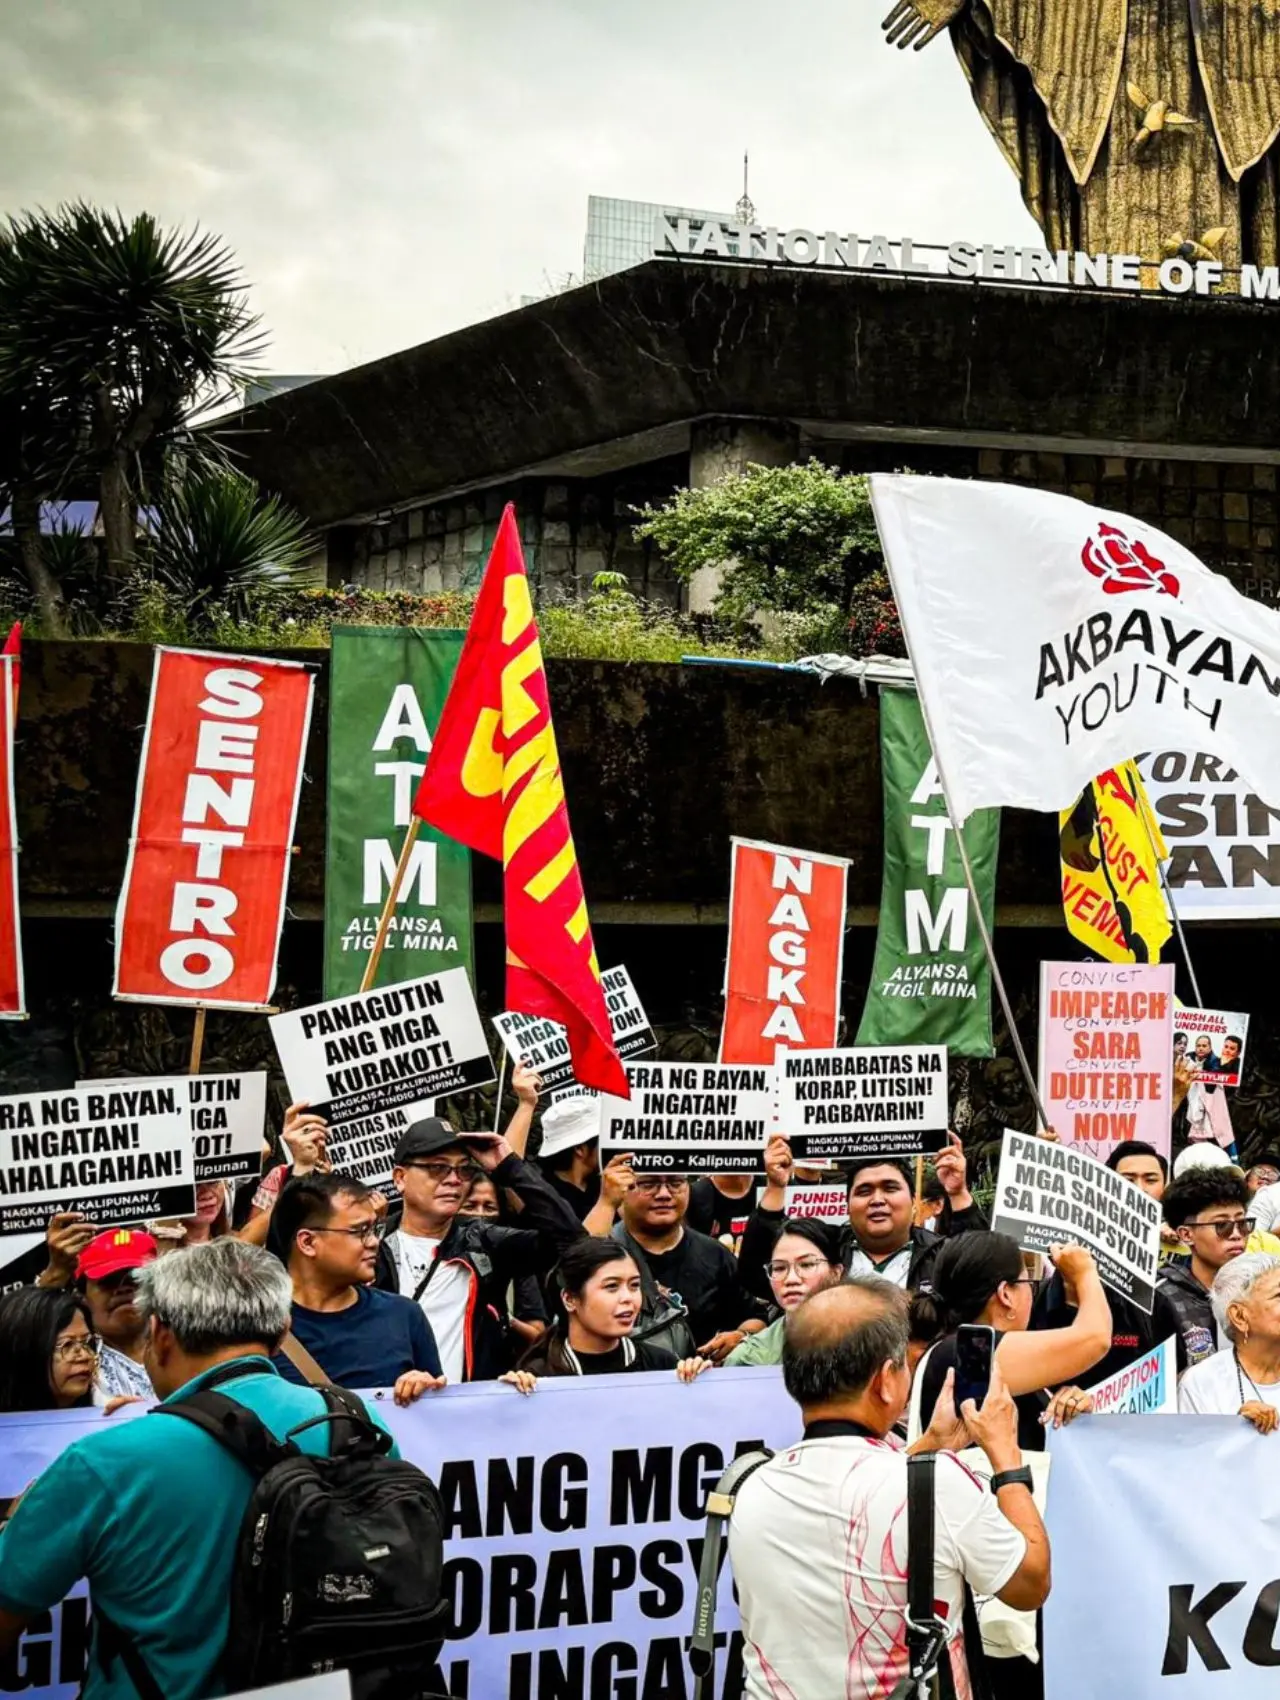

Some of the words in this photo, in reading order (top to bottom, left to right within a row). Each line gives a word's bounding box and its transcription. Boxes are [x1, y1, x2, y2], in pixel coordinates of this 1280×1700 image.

[653, 216, 929, 274] NATIONAL
[948, 240, 1140, 291] SHRINE
[1159, 258, 1222, 294] OF
[1056, 663, 1222, 744] YOUTH
[363, 683, 438, 907] ATM
[159, 668, 265, 991] SENTRO
[404, 936, 457, 951] MINA
[762, 857, 813, 1048] NAGKA
[890, 965, 968, 982] ALYANSA
[1059, 970, 1143, 987] CONVICT
[881, 982, 925, 998] TIGIL
[932, 983, 977, 999] MINA
[1050, 990, 1169, 1020] IMPEACH
[300, 980, 445, 1039] PANAGUTIN
[1207, 1014, 1225, 1025] ALL
[324, 1030, 379, 1067] ANG
[379, 1013, 441, 1051] MGA
[515, 1021, 558, 1049] MGA
[1073, 1031, 1142, 1060] SARA
[326, 1040, 456, 1098] KURAKOT!
[669, 1068, 698, 1090] NG
[702, 1069, 769, 1093] BAYAN,
[785, 1054, 913, 1079] MAMBABATAS
[917, 1053, 942, 1073] NA
[330, 1089, 385, 1112] NAGKAISA
[394, 1068, 455, 1093] KALIPUNAN
[331, 1103, 370, 1121] SIKLAB
[379, 1090, 416, 1108] TINDIG
[416, 1075, 467, 1097] PILIPINAS
[795, 1079, 858, 1101] KORAP,
[861, 1077, 933, 1099] LITISIN!
[1050, 1072, 1162, 1101] DUTERTE
[41, 1097, 80, 1126] NG
[88, 1088, 182, 1122] BAYAN,
[386, 1110, 408, 1128] NA
[643, 1093, 737, 1116] INGATAN!
[804, 1101, 924, 1125] PAGBAYARIN!
[610, 1118, 765, 1141] PAHALAGAHAN!
[807, 1135, 854, 1146] NAGKAISA
[862, 1132, 915, 1143] KALIPUNAN
[1074, 1113, 1137, 1141] NOW
[12, 1123, 140, 1162] INGATAN!
[806, 1145, 838, 1155] SIKLAB
[847, 1143, 878, 1153] TINDIG
[880, 1141, 923, 1152] PILIPINAS
[688, 1154, 758, 1169] Kalipunan
[1009, 1136, 1123, 1201] PANAGUTIN
[1124, 1190, 1158, 1225] ANG
[2, 1217, 46, 1231] SIKLAB
[102, 1203, 162, 1219] PILIPINAS
[3, 1203, 63, 1218] NAGKAISA
[76, 1194, 149, 1211] KALIPUNAN
[1015, 1163, 1066, 1196] MGA
[1071, 1179, 1151, 1245] SANGKOT
[1003, 1185, 1034, 1213] SA
[1039, 1194, 1155, 1275] KORAPSYON!
[438, 1451, 588, 1541] ANG
[697, 1586, 712, 1638] Canon
